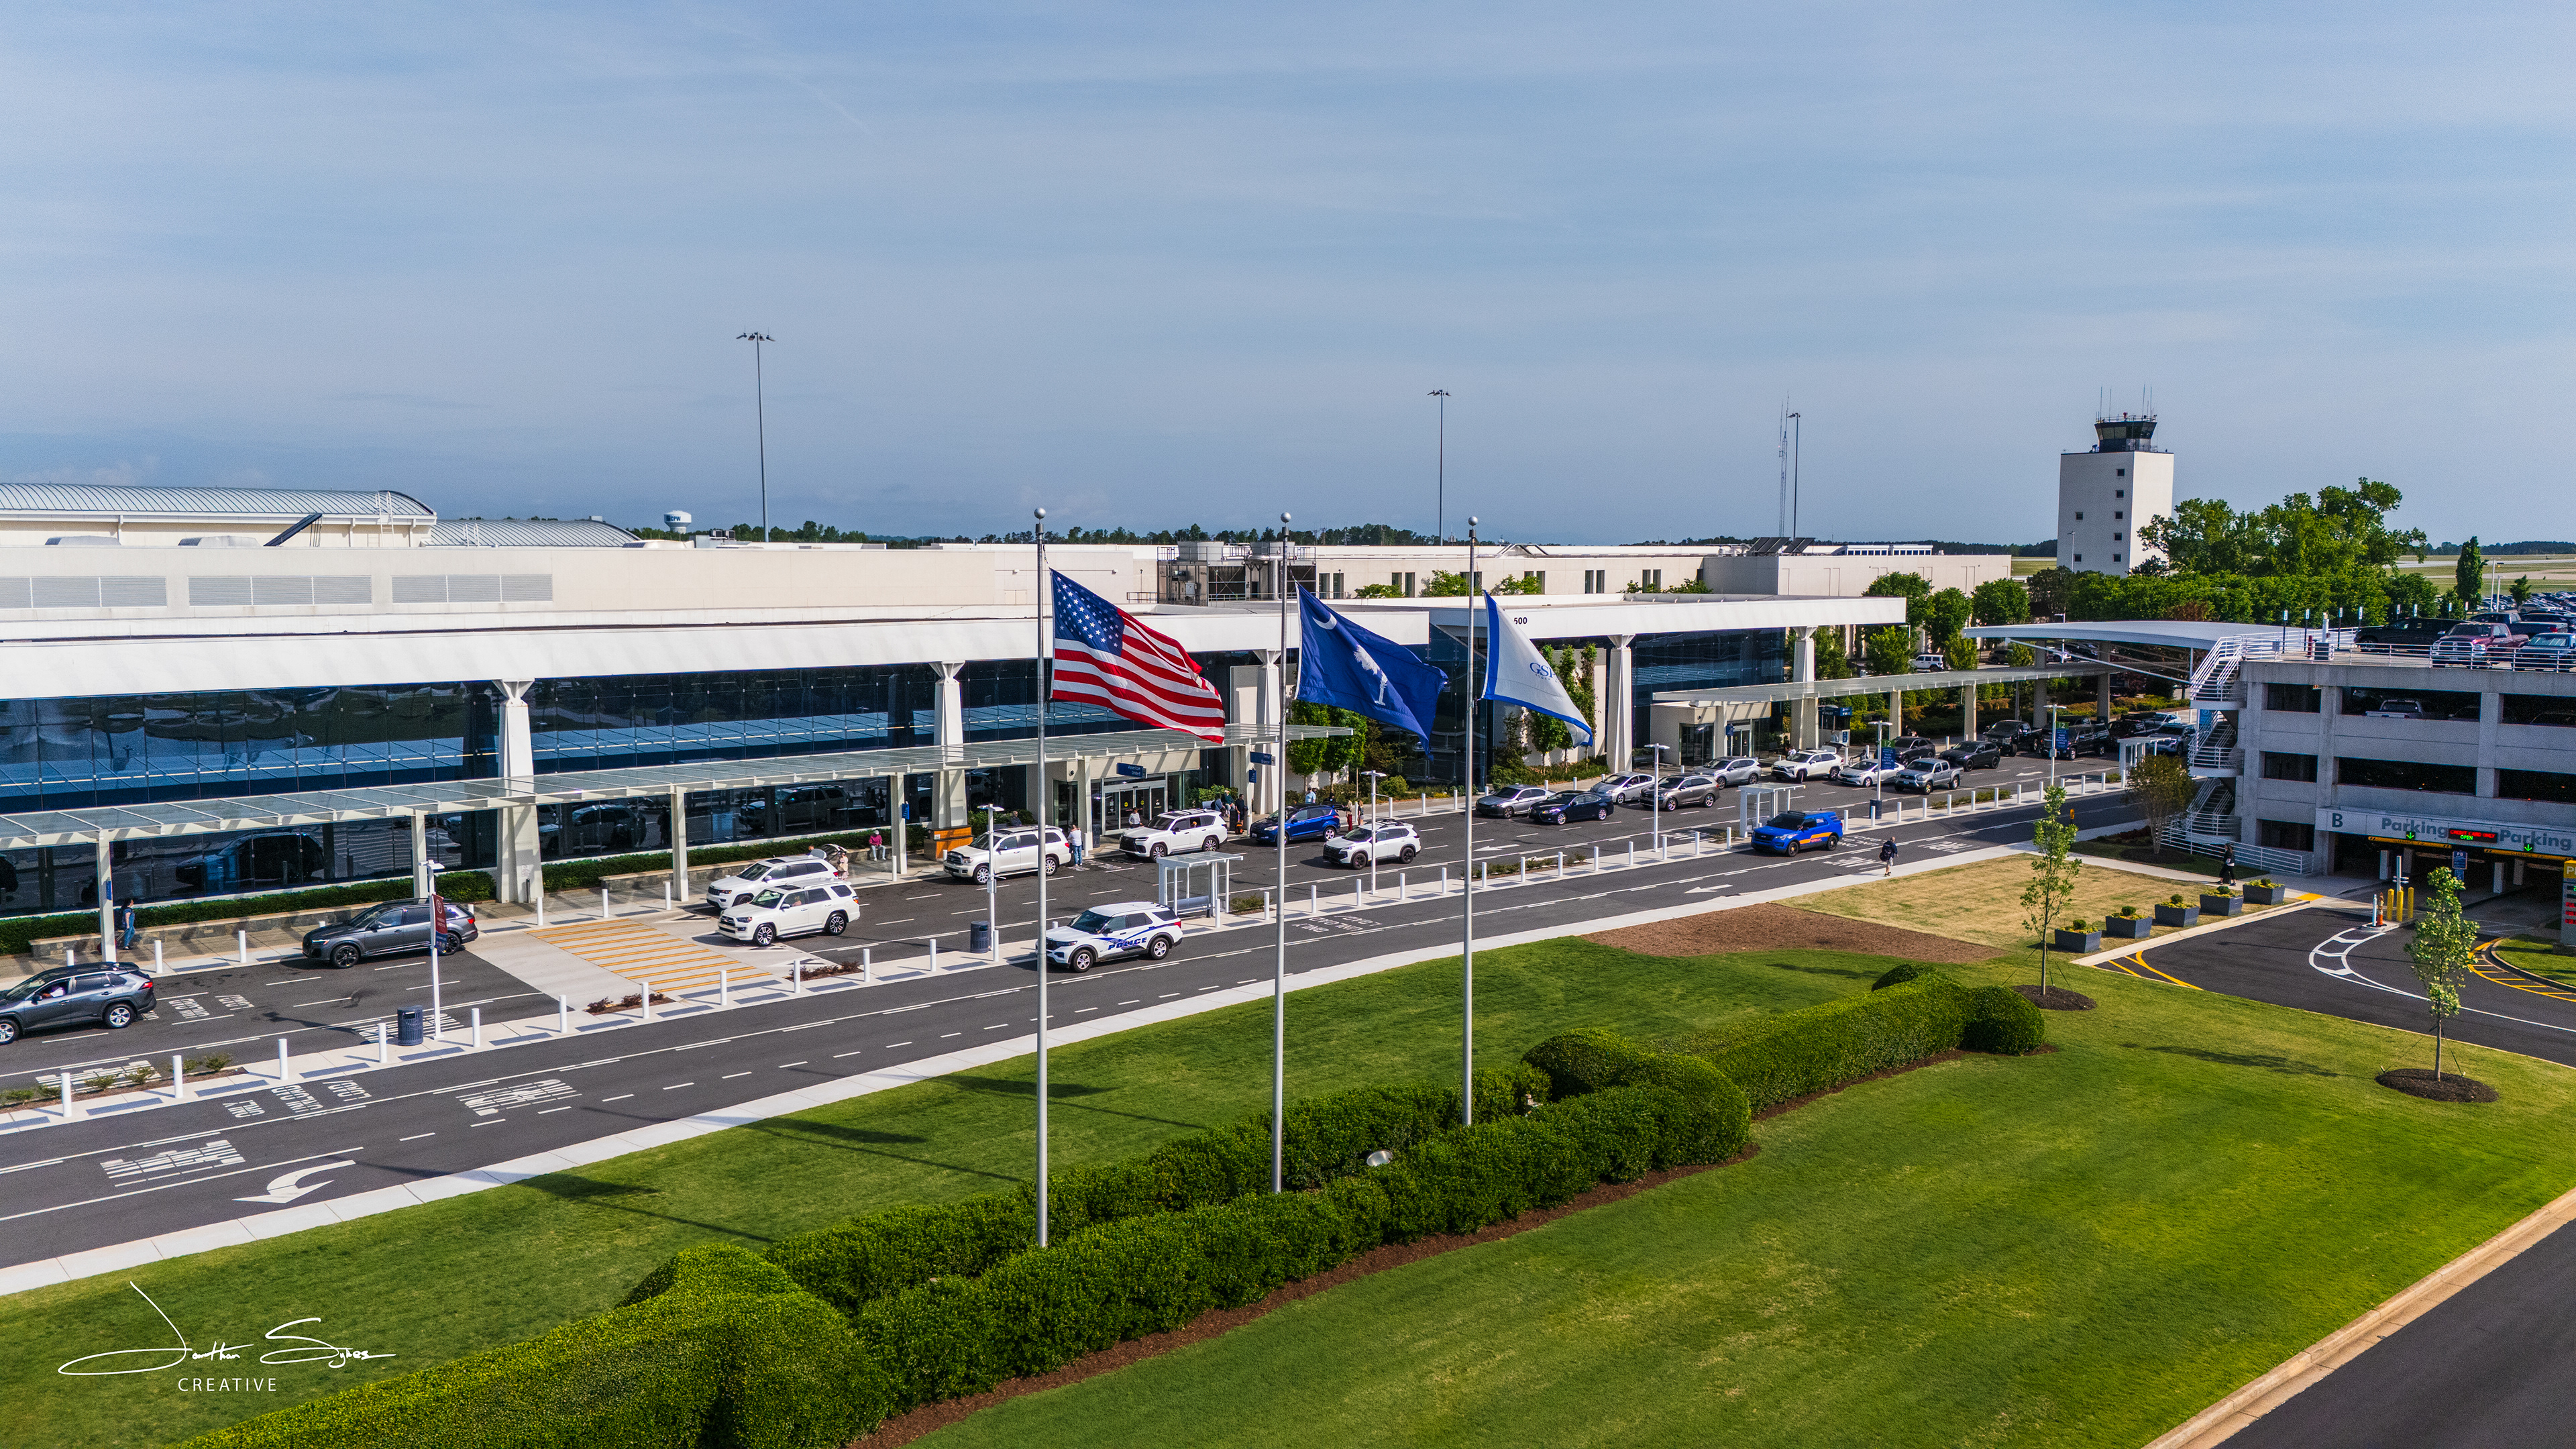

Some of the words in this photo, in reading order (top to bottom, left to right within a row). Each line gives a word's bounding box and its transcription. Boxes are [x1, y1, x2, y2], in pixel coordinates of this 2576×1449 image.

[1513, 616, 1528, 625] 500
[2332, 812, 2343, 828] B
[2381, 817, 2448, 839] Parking
[2500, 828, 2571, 851] Parking
[1108, 936, 1147, 951] POLICE
[222, 1099, 265, 1118] ONLY
[271, 1084, 323, 1113] UNLOAD
[455, 1079, 583, 1117] THRU
[100, 1139, 246, 1187] LANE
